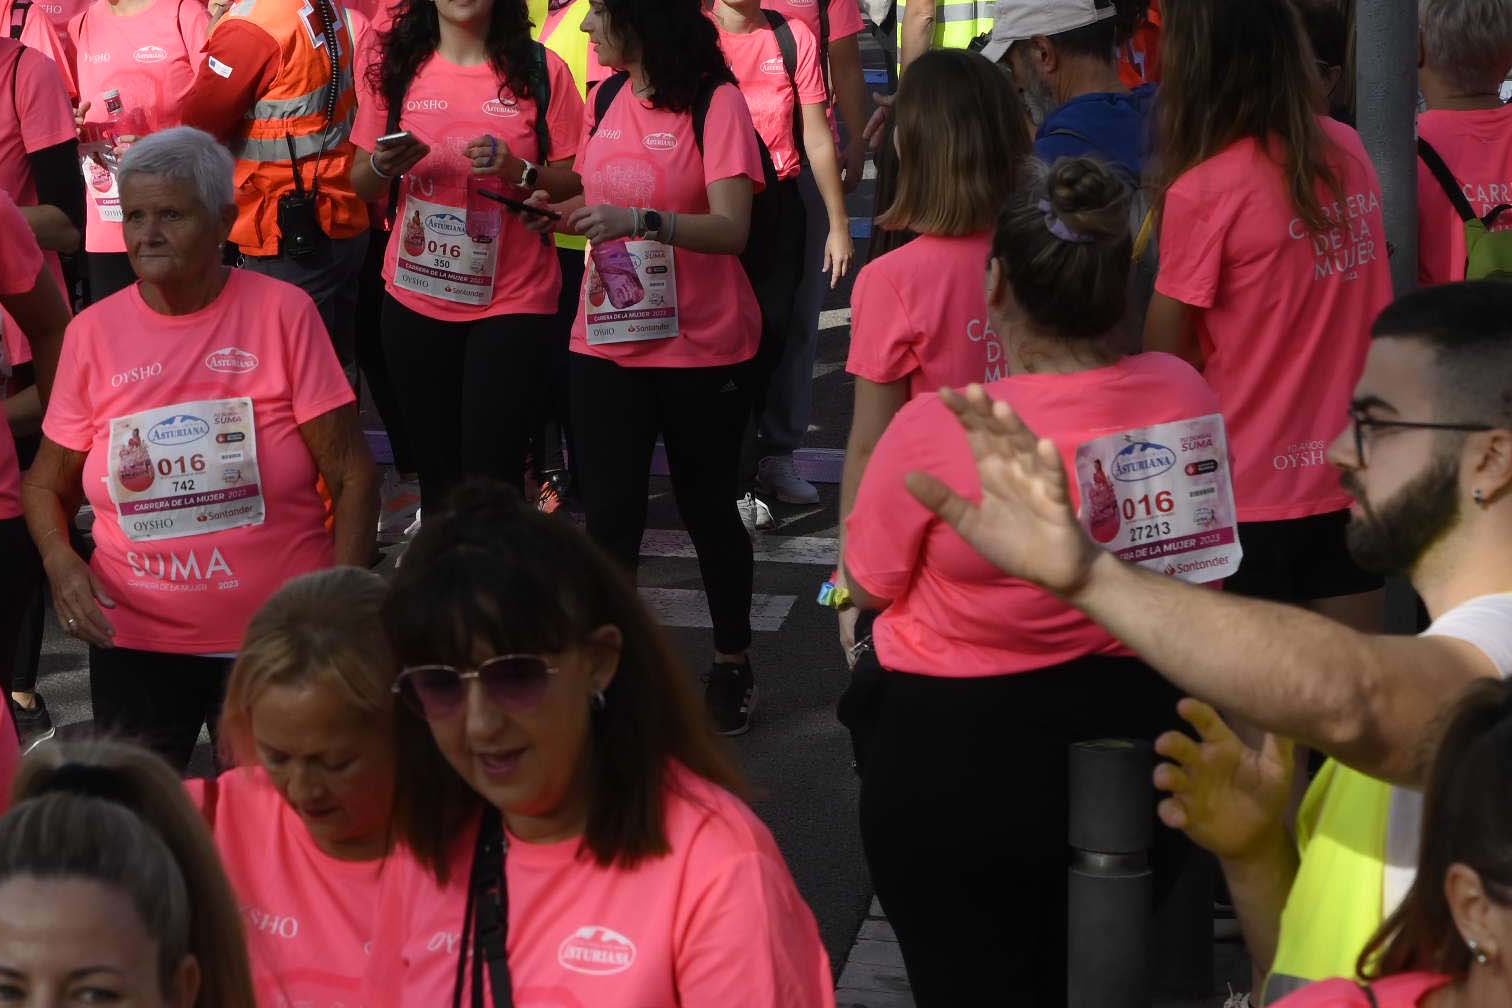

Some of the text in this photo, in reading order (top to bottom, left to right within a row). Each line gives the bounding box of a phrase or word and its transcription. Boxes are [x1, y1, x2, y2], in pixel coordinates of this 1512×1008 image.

[407, 99, 448, 112] OYSHO
[427, 240, 462, 258] 016
[433, 258, 451, 270] 350
[1315, 240, 1378, 281] MUJER
[402, 274, 485, 298] OYSHO Santander
[635, 322, 671, 333] Santander
[211, 355, 256, 369] ASTURIANA
[111, 362, 162, 388] OYSHO
[214, 415, 243, 425] SUMA
[152, 425, 206, 441] ASTURIANA
[1181, 438, 1214, 453] SUMA
[157, 453, 207, 476] 016
[1114, 456, 1171, 476] ASTURIANA
[172, 479, 196, 493] 742
[134, 500, 170, 512] CARRERA
[171, 498, 184, 508] DE
[184, 497, 196, 506] LA
[196, 493, 225, 505] MUJER
[1122, 490, 1175, 520] 016
[133, 505, 254, 531] OYSHO Santander
[1129, 521, 1172, 542] 27213
[1135, 547, 1149, 558] DE
[1148, 544, 1162, 556] LA
[1162, 538, 1196, 554] MUJER
[126, 546, 234, 582] SUMA
[1176, 555, 1230, 575] Santander
[218, 580, 239, 590] 2023
